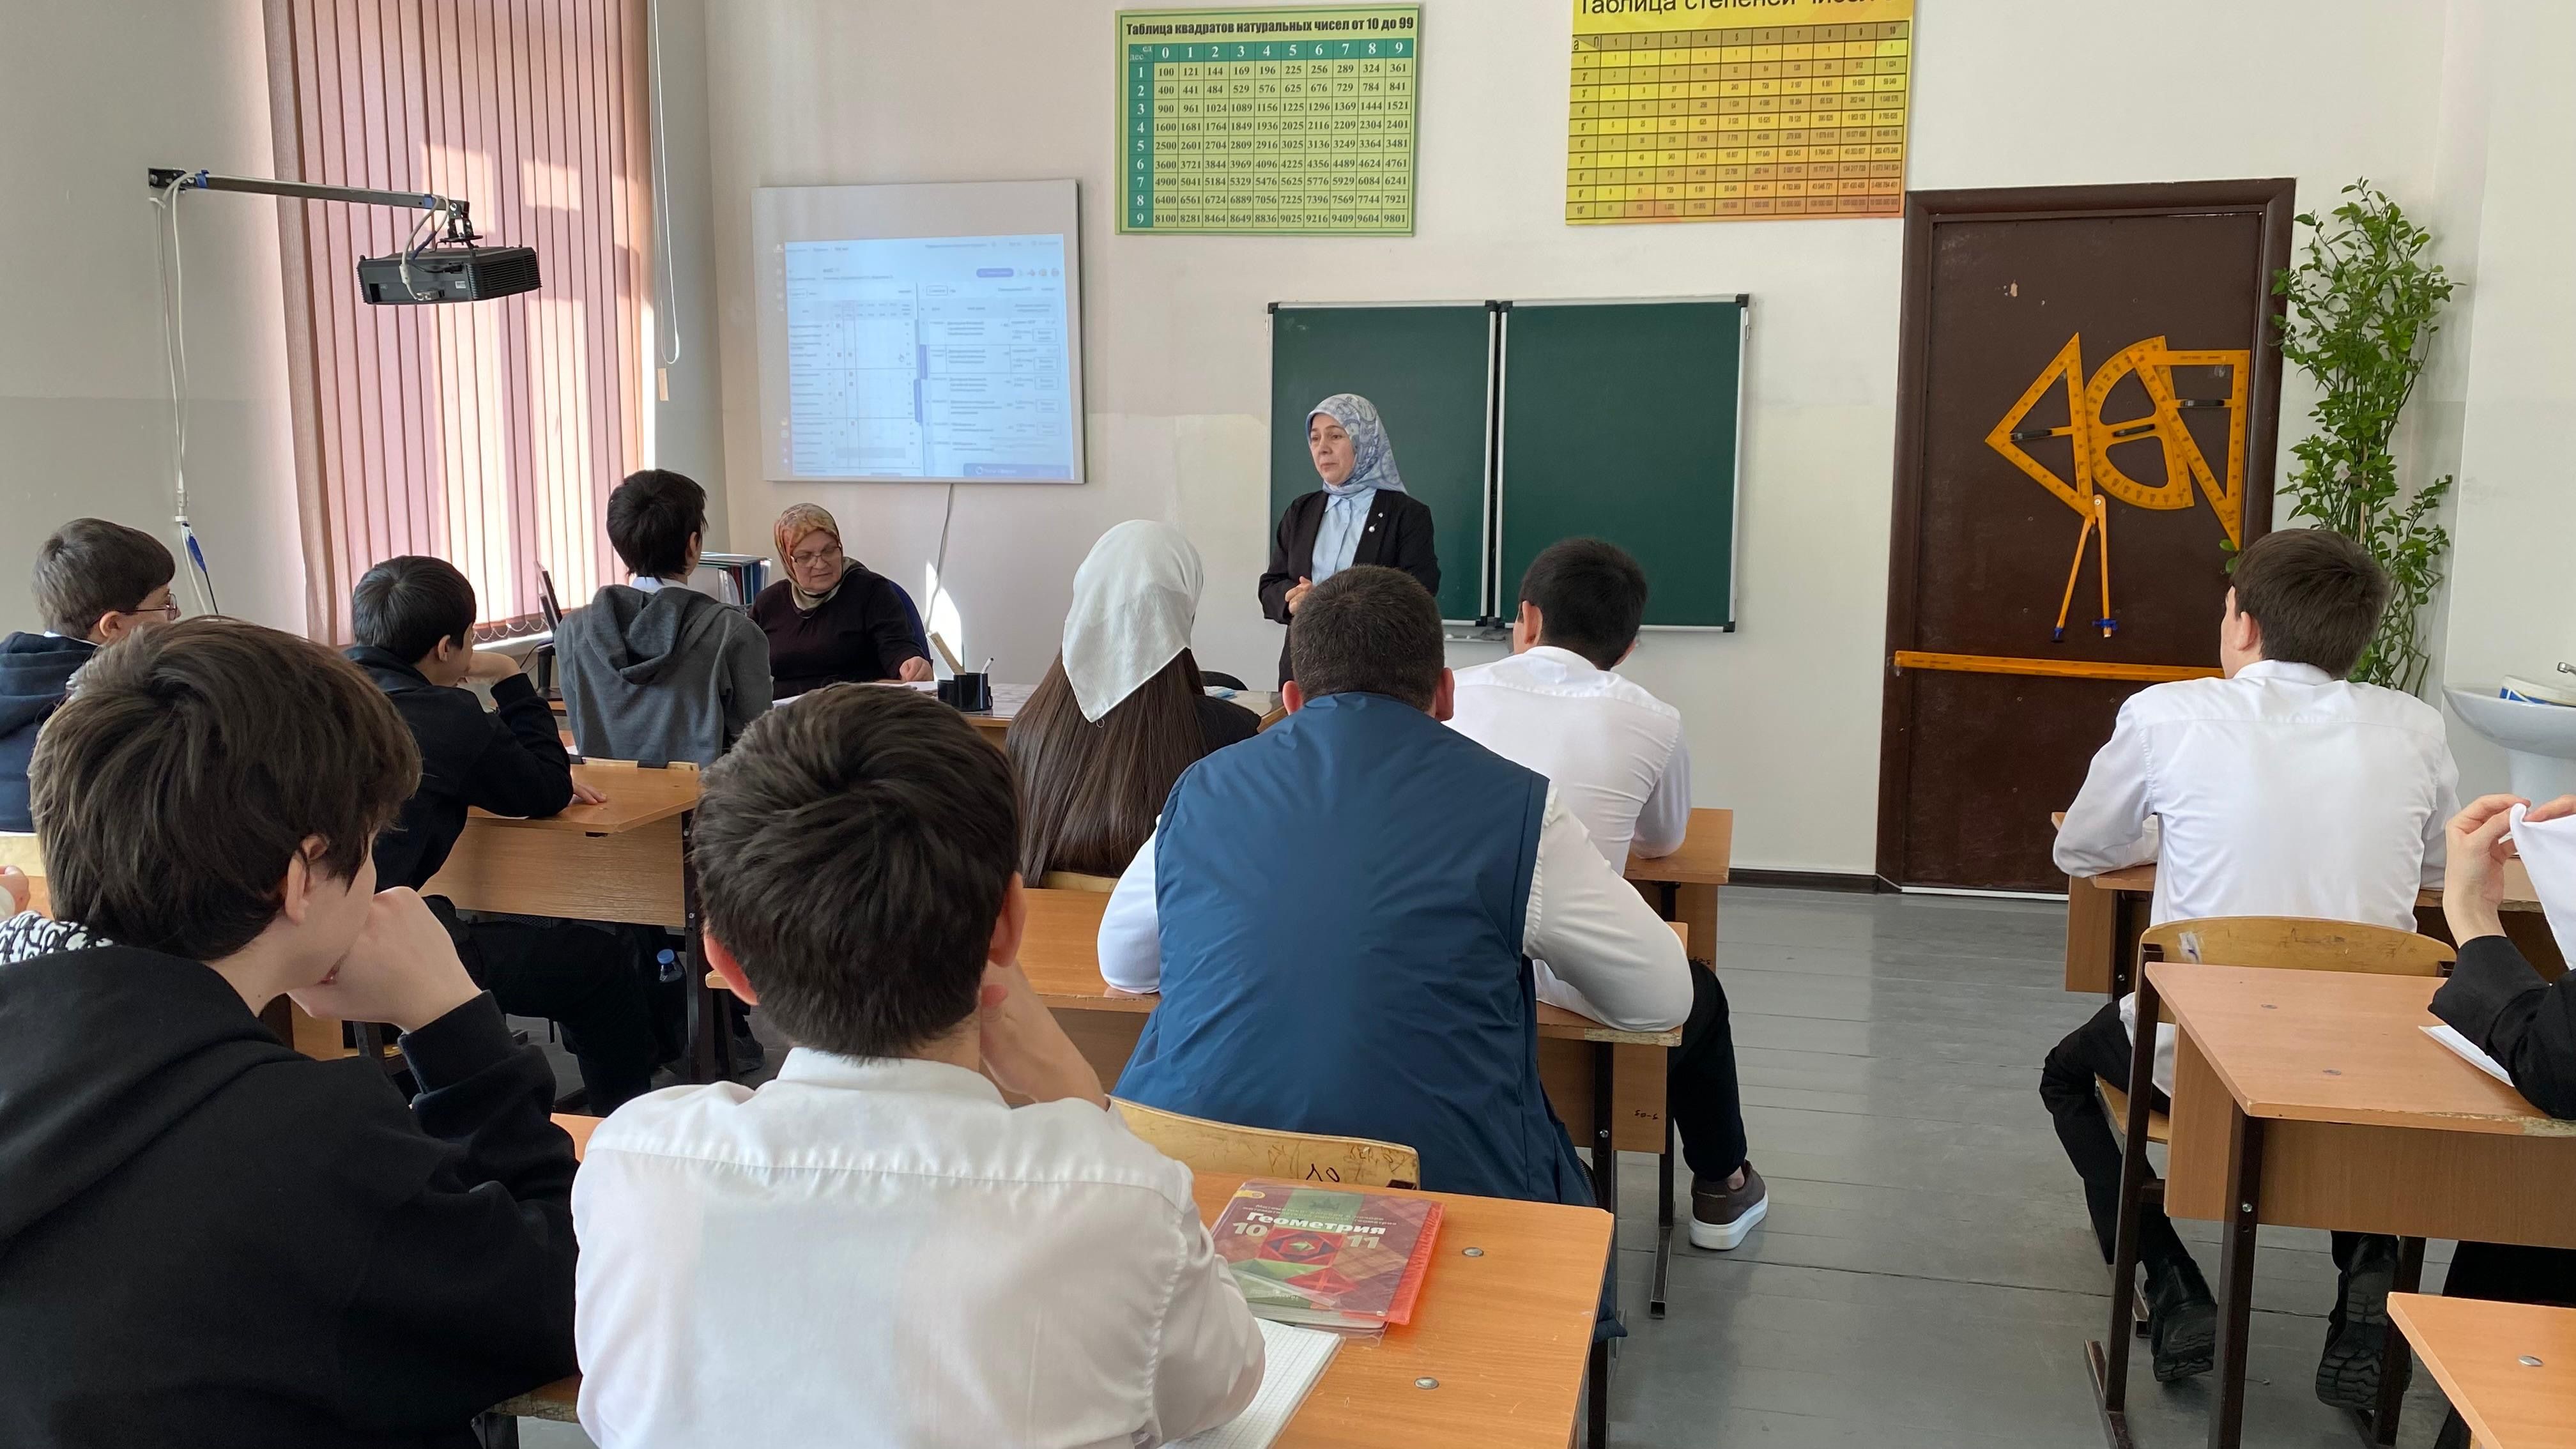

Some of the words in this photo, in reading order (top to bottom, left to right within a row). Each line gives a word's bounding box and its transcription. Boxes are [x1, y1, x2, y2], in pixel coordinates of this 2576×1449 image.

[1126, 23, 1173, 36] Таблица
[1175, 22, 1234, 35] квадратов
[1237, 20, 1312, 34] натуральных
[1314, 19, 1350, 31] чисел
[1352, 19, 1365, 29] от
[1367, 17, 1379, 29] 10
[1381, 19, 1397, 31] до
[1399, 17, 1414, 29] 99
[1162, 47, 1169, 59] 0
[1187, 47, 1193, 58] 1
[1211, 45, 1219, 57] 2
[1237, 45, 1245, 57] 3
[1262, 45, 1270, 56] 4
[1289, 44, 1297, 56] 5
[1315, 43, 1323, 56] 6
[1342, 43, 1349, 56] 7
[1368, 42, 1376, 54] 8
[1395, 42, 1403, 54] 9
[1138, 66, 1144, 78] 1
[1159, 68, 1174, 77] 100
[1184, 67, 1198, 76] 121
[1208, 66, 1223, 76] 144
[1234, 66, 1250, 75] 169
[1260, 66, 1276, 75] 196
[1285, 65, 1302, 75] 225
[1311, 65, 1328, 74] 256
[1337, 65, 1354, 73] 289
[1363, 63, 1380, 73] 324
[1390, 63, 1406, 72] 361
[1137, 85, 1144, 96] 2
[1158, 86, 1174, 95] 400
[1183, 86, 1198, 95] 441
[1206, 85, 1223, 94] 484
[1233, 84, 1250, 94] 529
[1259, 84, 1276, 93] 576
[1284, 84, 1301, 93] 625
[1310, 83, 1328, 93] 676
[1337, 82, 1354, 92] 729
[1362, 82, 1379, 91] 784
[1390, 82, 1406, 91] 841
[1137, 103, 1144, 115] 3
[1158, 105, 1174, 113] 900
[1183, 104, 1199, 113] 961
[1206, 103, 1227, 112] 1024
[1232, 103, 1252, 112] 1089
[1257, 103, 1278, 112] 1156
[1283, 102, 1304, 112] 1225
[1309, 102, 1330, 111] 1296
[1335, 102, 1356, 111] 1369
[1361, 102, 1383, 111] 1444
[1388, 101, 1408, 110] 1521
[1137, 121, 1144, 134] 4
[1156, 123, 1177, 132] 1600
[1181, 122, 1200, 132] 1681
[1206, 122, 1227, 131] 1764
[1232, 122, 1252, 131] 1849
[1257, 121, 1278, 130] 1936
[1282, 121, 1304, 130] 2025
[1308, 121, 1330, 130] 2116
[1333, 121, 1356, 130] 2209
[1360, 120, 1382, 129] 2304
[1386, 119, 1408, 129] 2401
[1137, 140, 1144, 151] 5
[1155, 141, 1177, 150] 2500
[1181, 141, 1201, 150] 2601
[1205, 141, 1227, 150] 2704
[1230, 141, 1252, 150] 2809
[1256, 140, 1278, 149] 2916
[1281, 140, 1304, 149] 3025
[1307, 140, 1330, 149] 3136
[1333, 139, 1356, 148] 3249
[1359, 139, 1381, 148] 3364
[1386, 139, 1407, 148] 3481
[1137, 158, 1144, 170] 6
[1155, 160, 1177, 169] 3600
[1180, 160, 1201, 169] 3721
[1205, 160, 1226, 169] 3844
[1230, 160, 1252, 169] 3969
[1255, 160, 1278, 169] 4096
[1280, 159, 1303, 169] 4225
[1307, 159, 1330, 169] 4356
[1333, 159, 1355, 168] 4489
[1358, 159, 1381, 168] 4624
[1385, 158, 1407, 167] 4761
[1137, 176, 1144, 188] 7
[1155, 178, 1177, 186] 4900
[1180, 178, 1200, 186] 5041
[1204, 177, 1226, 186] 5184
[1230, 177, 1252, 186] 5329
[1255, 177, 1277, 186] 5476
[1280, 177, 1303, 186] 5625
[1307, 176, 1330, 186] 5776
[1332, 176, 1355, 185] 5929
[1358, 176, 1380, 185] 6084
[1384, 176, 1406, 185] 6241
[1137, 195, 1144, 206] 8
[1155, 195, 1176, 204] 6400
[1180, 195, 1200, 204] 6561
[1205, 195, 1226, 204] 6724
[1230, 195, 1252, 204] 6889
[1255, 195, 1277, 204] 7056
[1280, 195, 1303, 204] 7225
[1306, 195, 1329, 204] 7396
[1331, 195, 1354, 204] 7569
[1358, 195, 1380, 204] 7744
[1384, 195, 1406, 204] 7921
[1137, 213, 1144, 224] 9
[1154, 214, 1176, 223] 8100
[1180, 214, 1200, 223] 8281
[1204, 214, 1226, 223] 8464
[1230, 214, 1252, 223] 8649
[1255, 214, 1277, 223] 8836
[1280, 214, 1302, 223] 9025
[1306, 214, 1328, 223] 9216
[1331, 214, 1354, 223] 9409
[1357, 214, 1379, 223] 9604
[1384, 214, 1405, 223] 9801
[1232, 1222, 1268, 1237] 10
[1246, 1212, 1386, 1236] Геометрия
[1347, 1234, 1380, 1249] 11
